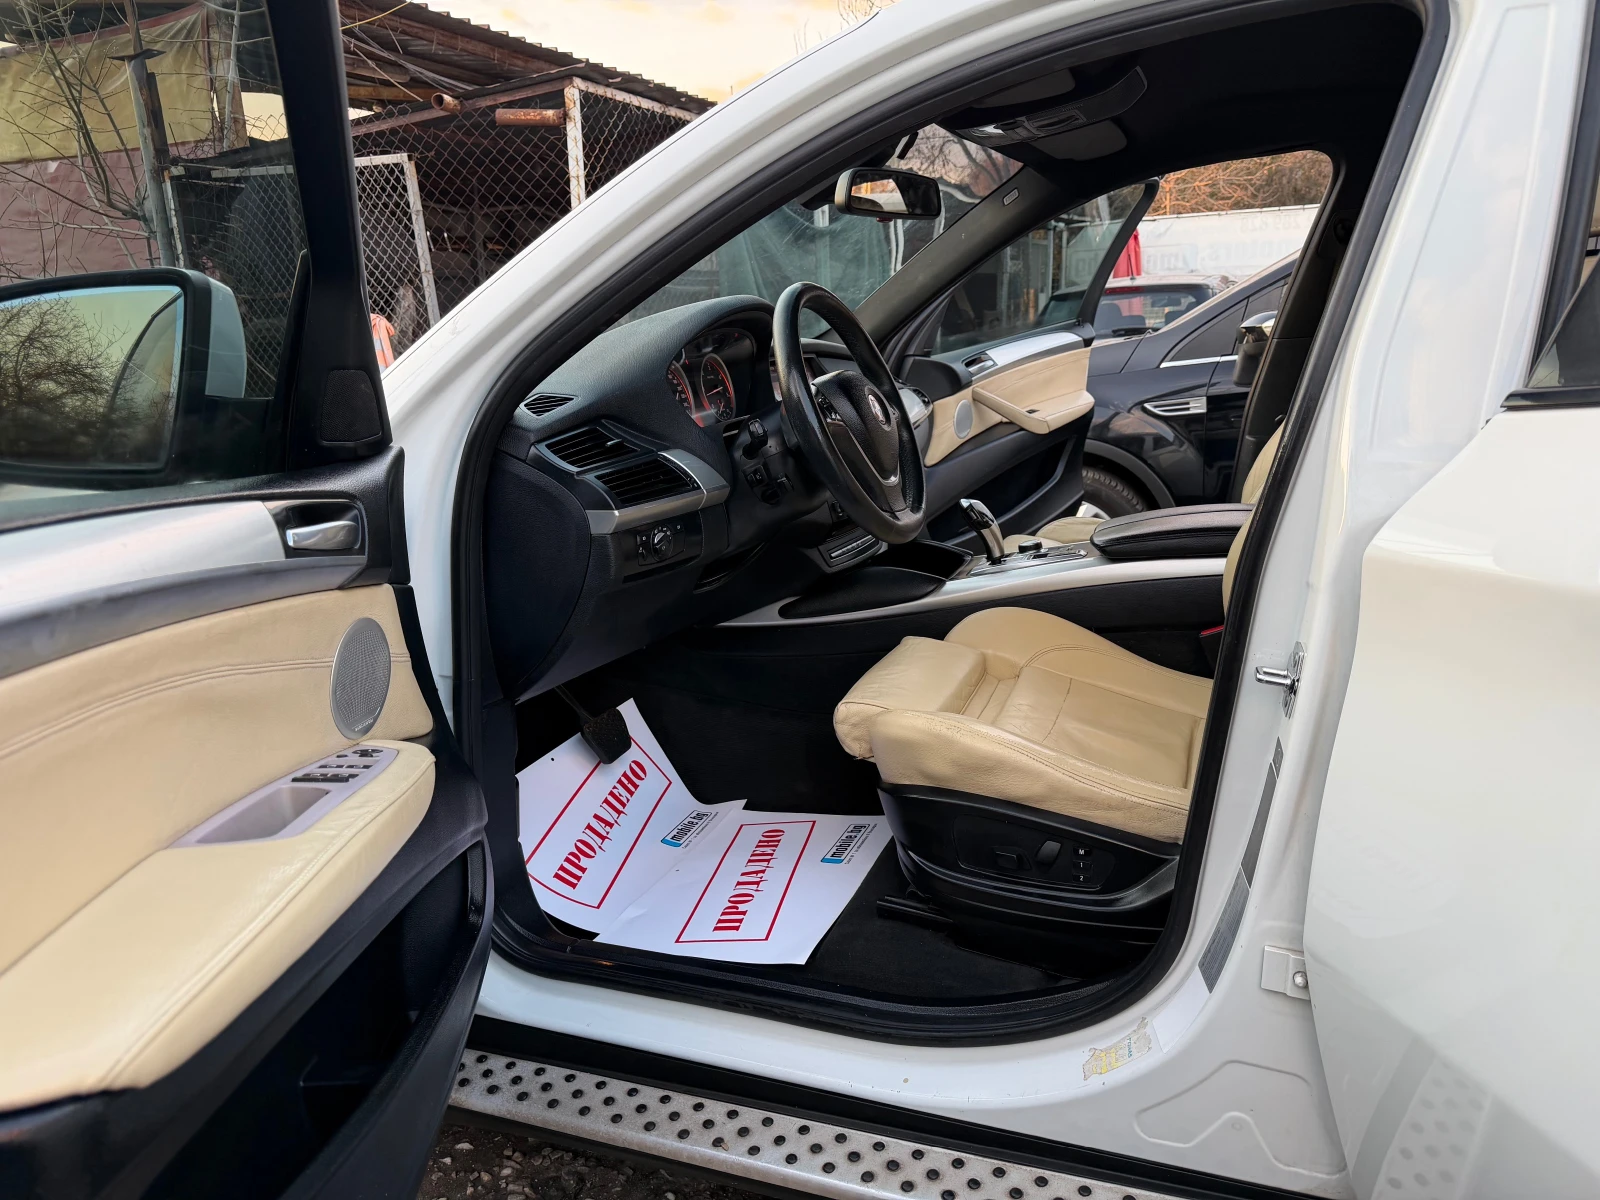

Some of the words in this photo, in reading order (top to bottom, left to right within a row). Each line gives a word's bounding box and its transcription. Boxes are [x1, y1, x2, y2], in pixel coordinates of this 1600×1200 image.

[553, 759, 647, 890] ПРОДАДЕНО
[670, 812, 708, 842] mobile.bg
[830, 825, 867, 858] mobile.bg
[713, 828, 785, 932] ПРОДАДЕНО
